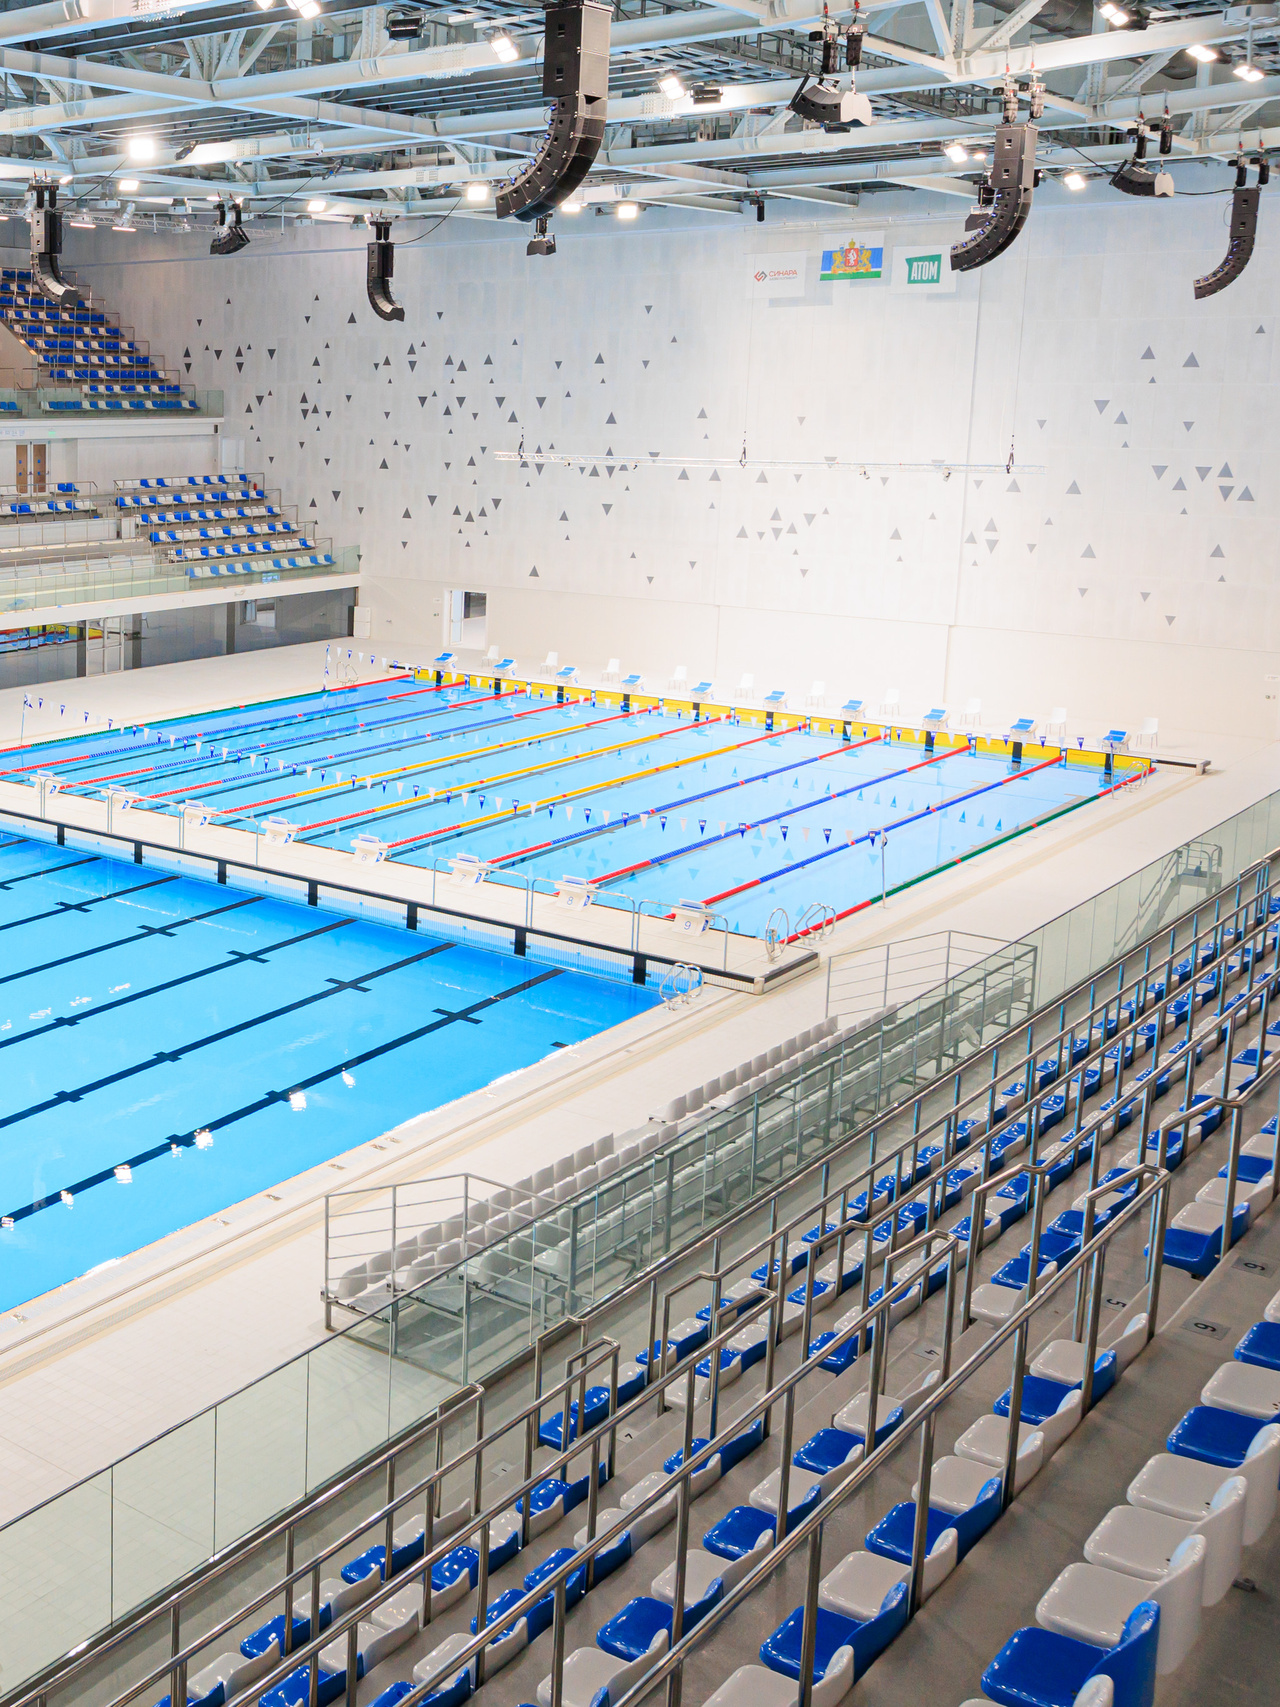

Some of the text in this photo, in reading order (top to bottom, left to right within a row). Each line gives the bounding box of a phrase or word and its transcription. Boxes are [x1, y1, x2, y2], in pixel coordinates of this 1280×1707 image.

[768, 269, 798, 277] СИНАРА
[910, 261, 938, 280] АТОМ
[271, 834, 277, 843] 5
[361, 853, 368, 862] 6
[460, 873, 467, 882] 7
[567, 896, 574, 906] 8
[683, 920, 692, 931] 9
[1106, 1298, 1127, 1308] 5
